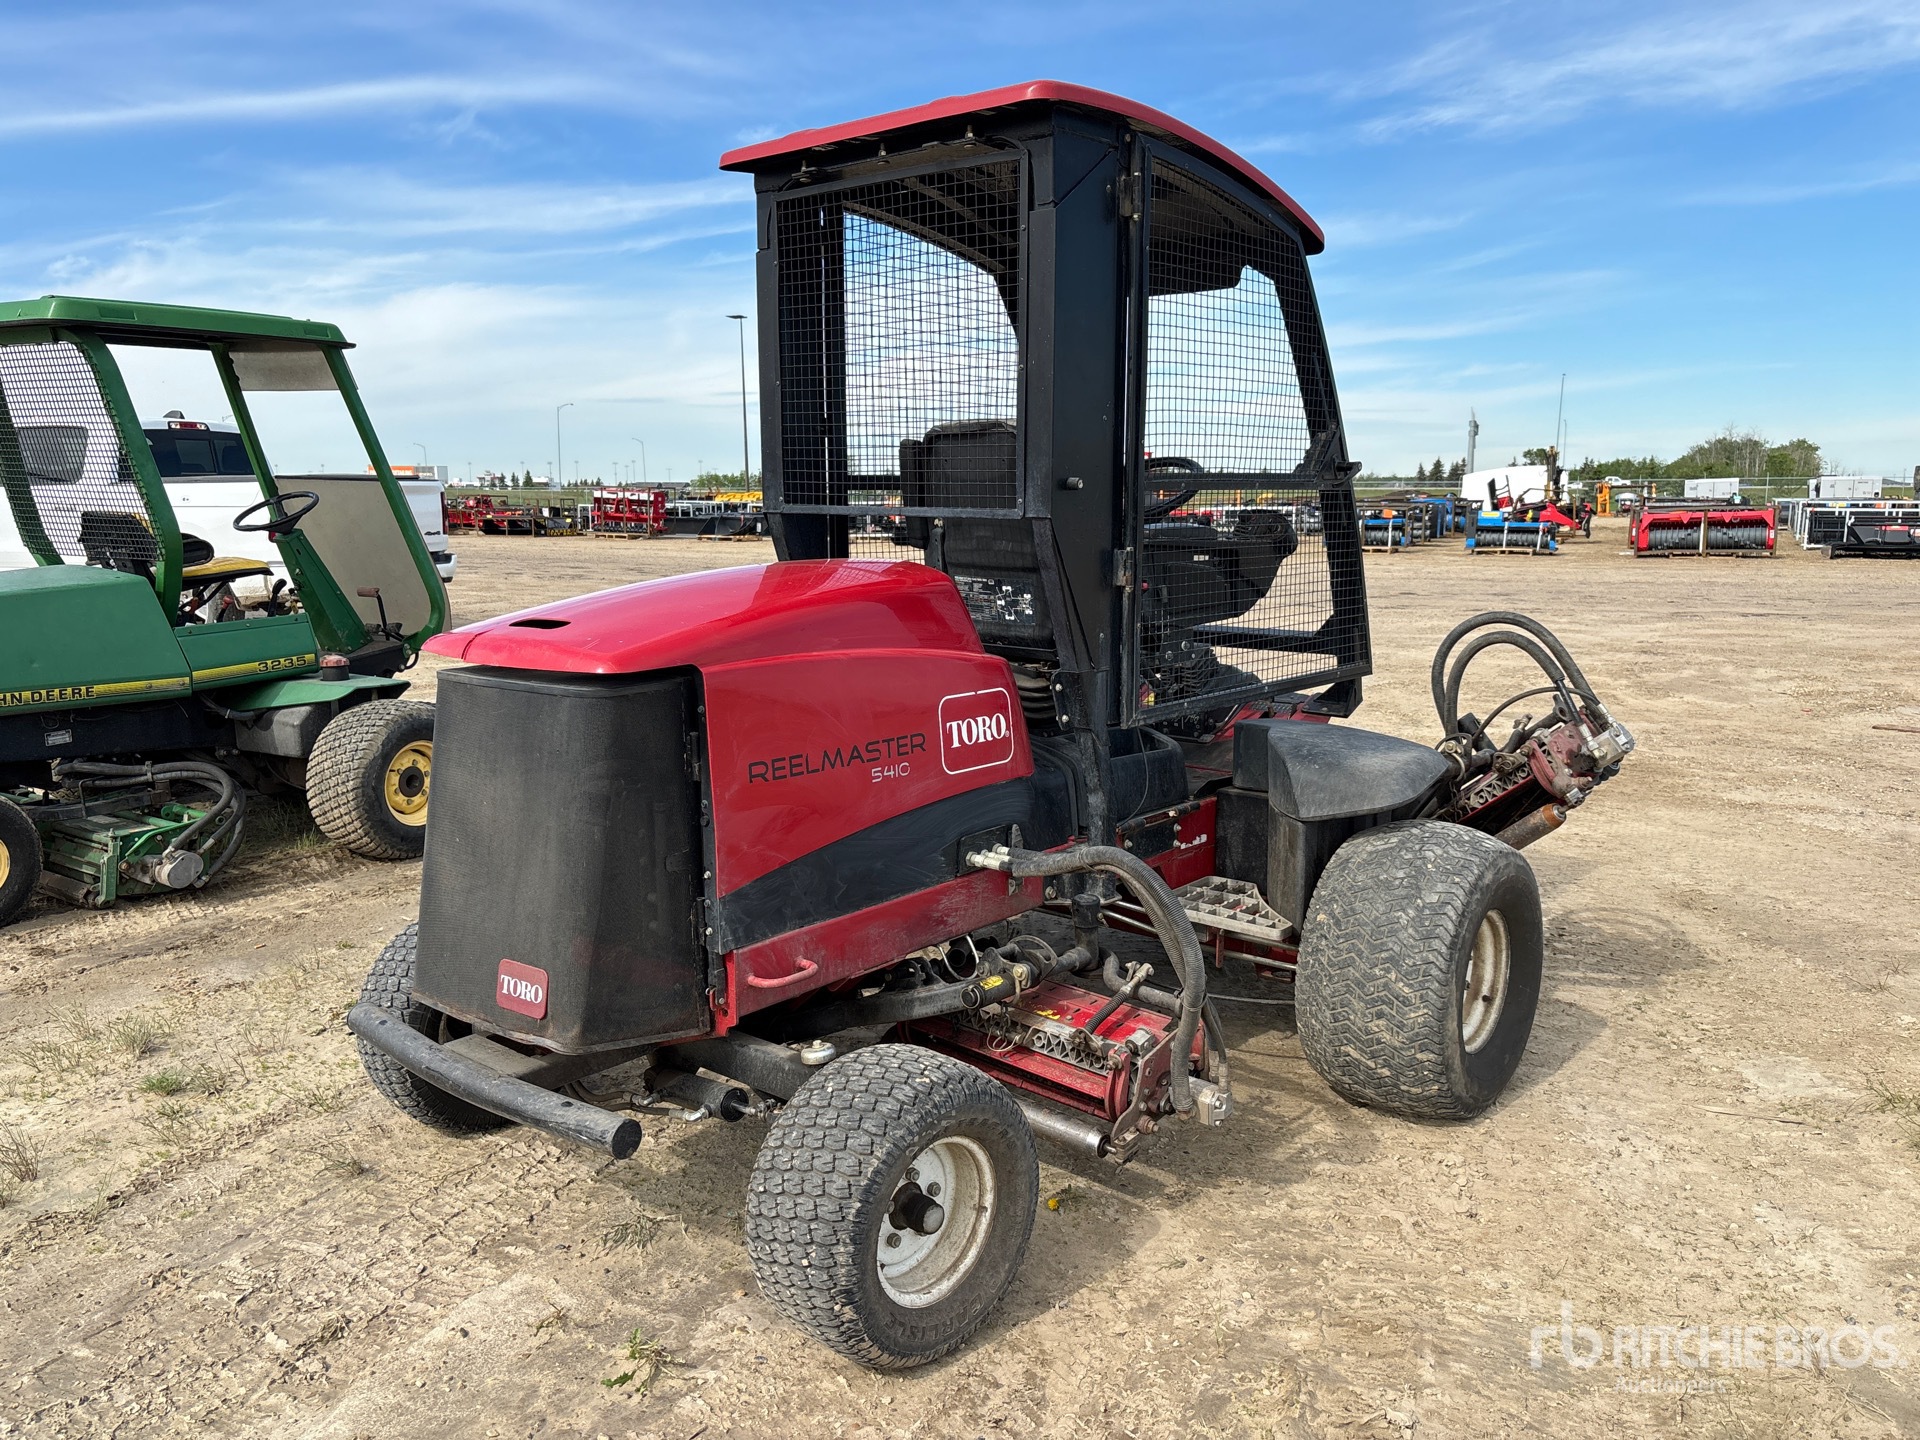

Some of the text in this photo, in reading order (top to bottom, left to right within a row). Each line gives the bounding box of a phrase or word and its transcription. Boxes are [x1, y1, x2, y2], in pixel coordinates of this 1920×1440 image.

[258, 656, 307, 672] 3235
[31, 686, 94, 703] DEERE
[946, 712, 1006, 749] TORO
[748, 732, 926, 784] REELMASTER
[871, 762, 910, 783] 5410
[500, 974, 543, 1004] TORO
